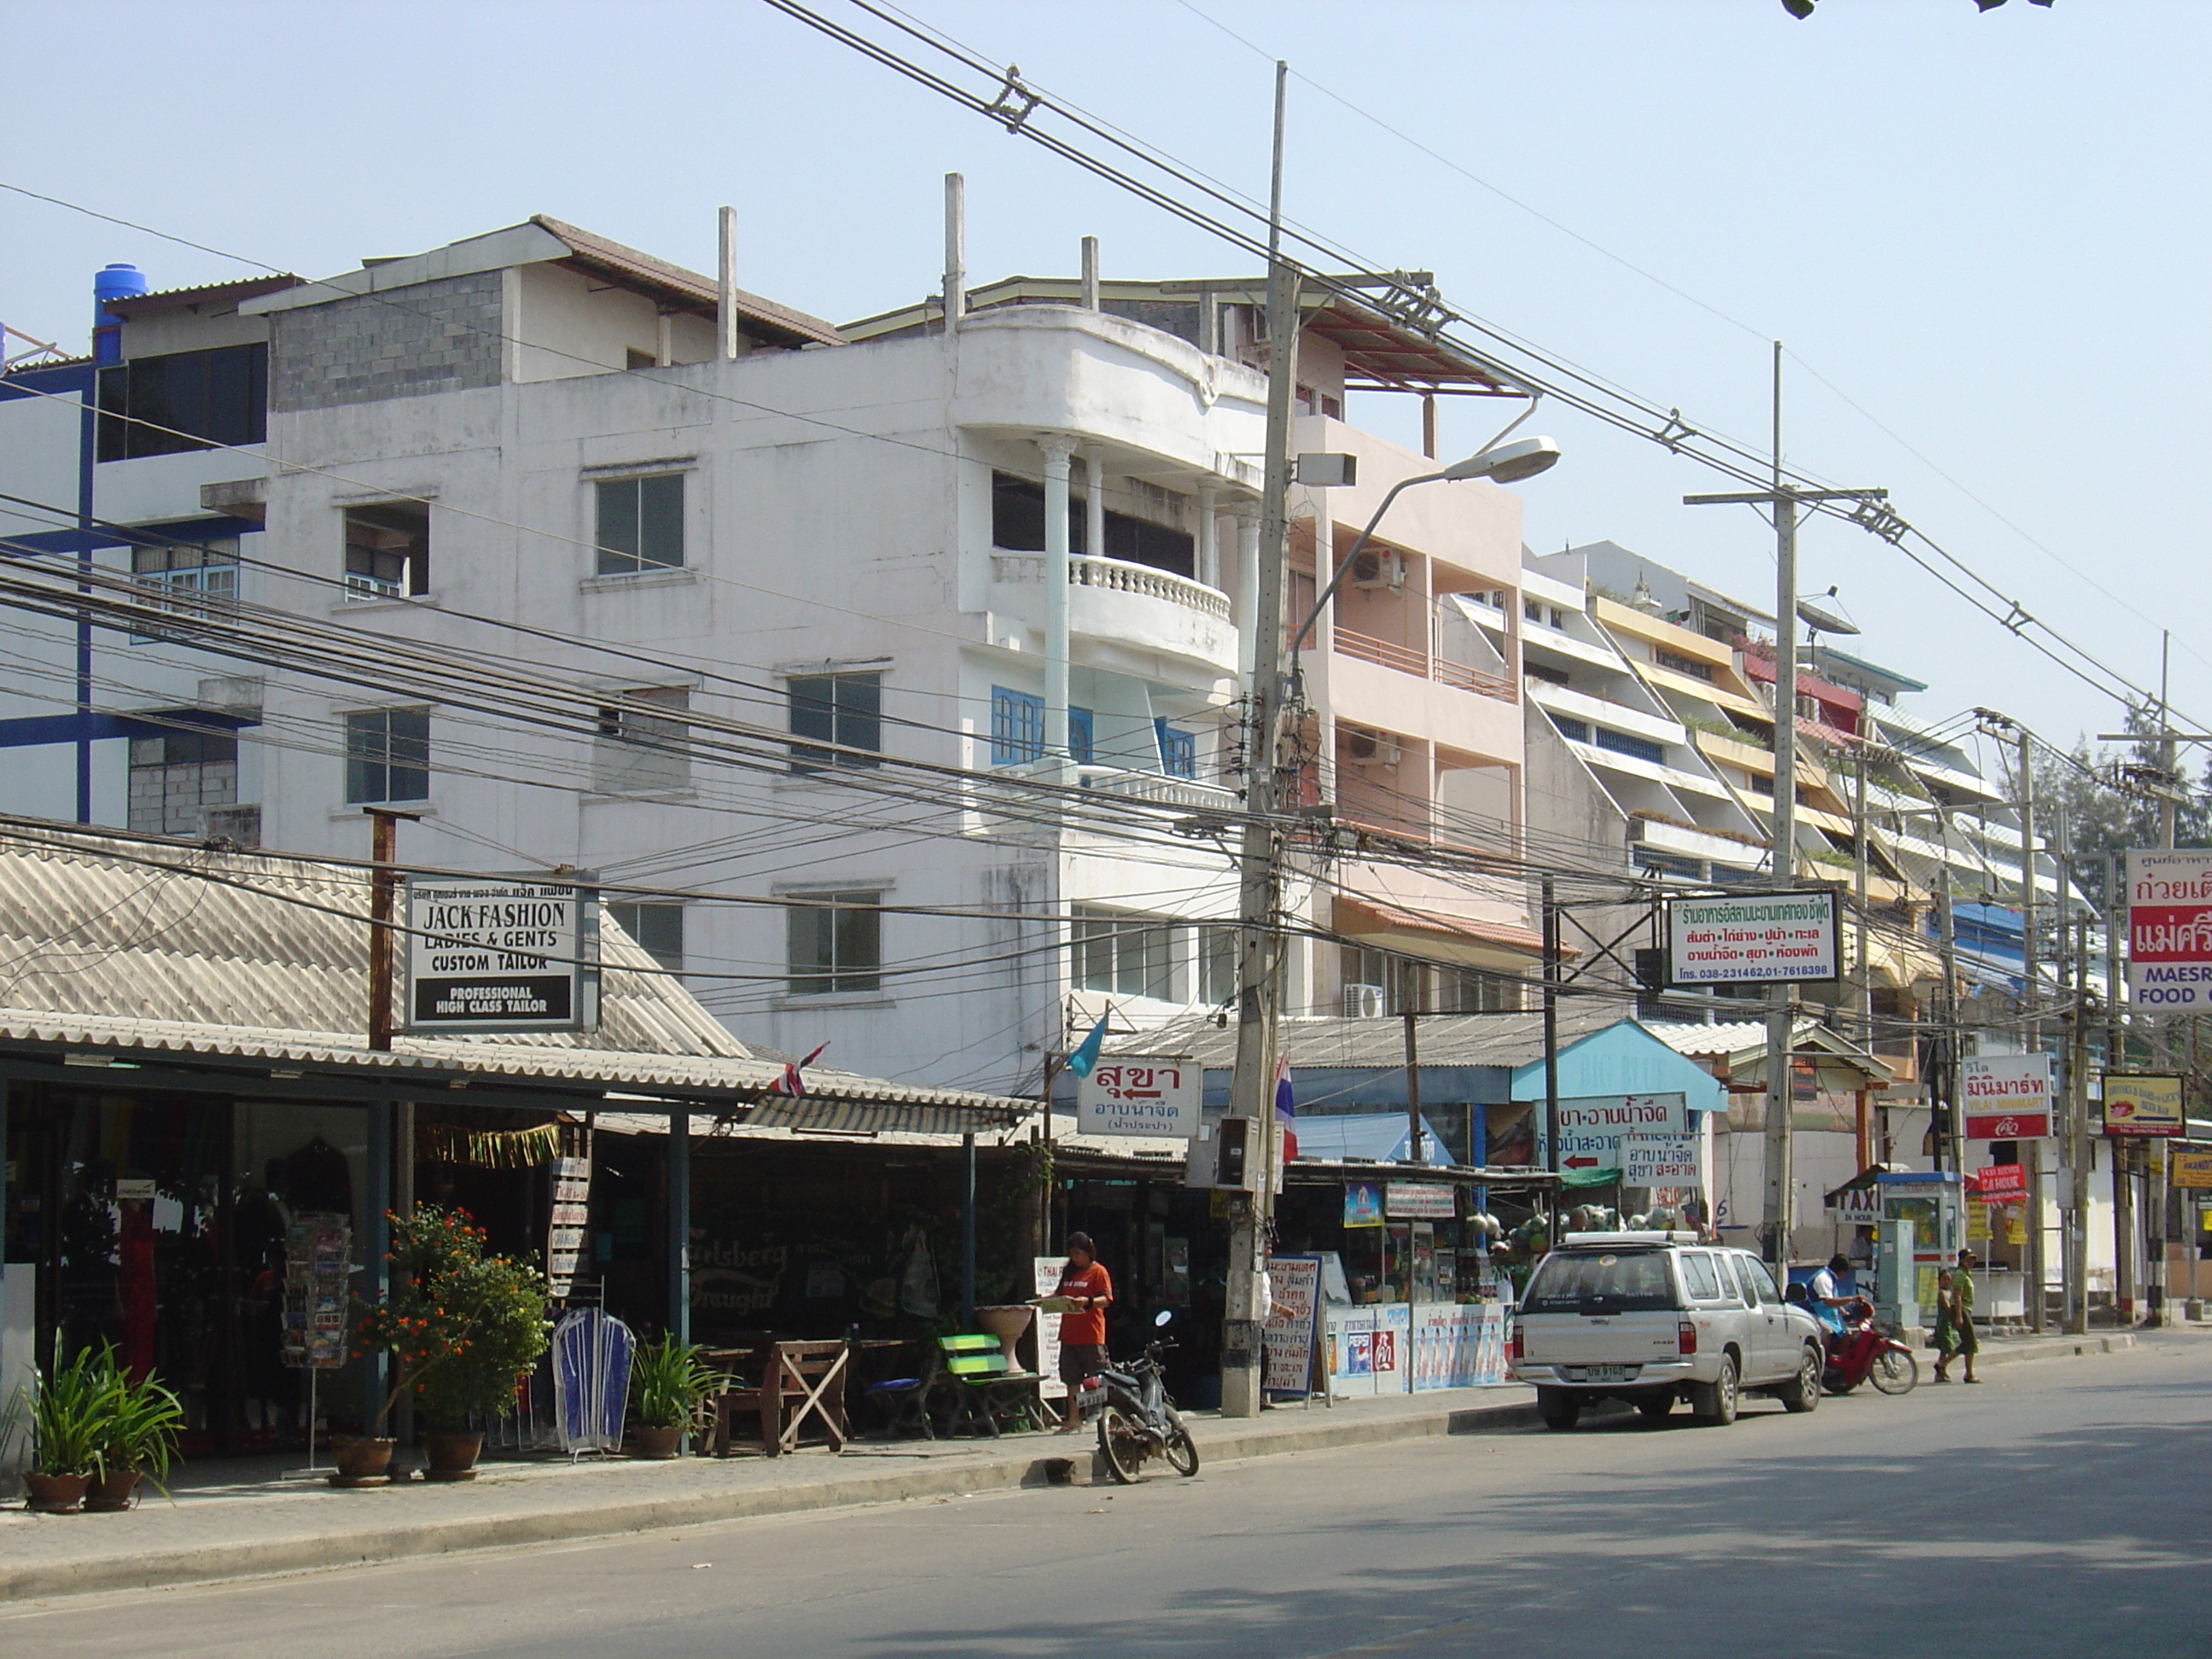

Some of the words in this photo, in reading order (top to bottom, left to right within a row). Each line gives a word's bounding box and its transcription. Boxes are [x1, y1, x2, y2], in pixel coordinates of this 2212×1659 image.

[423, 905, 473, 930] JACK
[479, 902, 565, 928] FASHION
[424, 932, 480, 950] LADIES
[504, 931, 557, 947] GENTS
[1722, 928, 1757, 942] ไก่ย่าง
[1795, 928, 1819, 939] ทะเล
[432, 954, 489, 971] CUSTOM
[498, 952, 547, 969] TAILOR
[1746, 949, 1767, 963] สุขา
[450, 987, 533, 1000] PROFESSIONAL
[2139, 988, 2195, 1004] FOOD
[436, 1001, 464, 1013] HIGH
[469, 1000, 502, 1013] CLASS
[507, 999, 547, 1012] TAILOR
[1096, 1065, 1180, 1099] สุขา
[1968, 1099, 1993, 1110] VILAI
[1996, 1097, 2044, 1109] MINIMART
[1656, 1163, 1697, 1177] สะอาด
[1836, 1190, 1881, 1211] TAXI
[1854, 1214, 1872, 1222] HOUR
[689, 1240, 789, 1273] arlsberg
[1348, 1335, 1370, 1347] PEPSI
